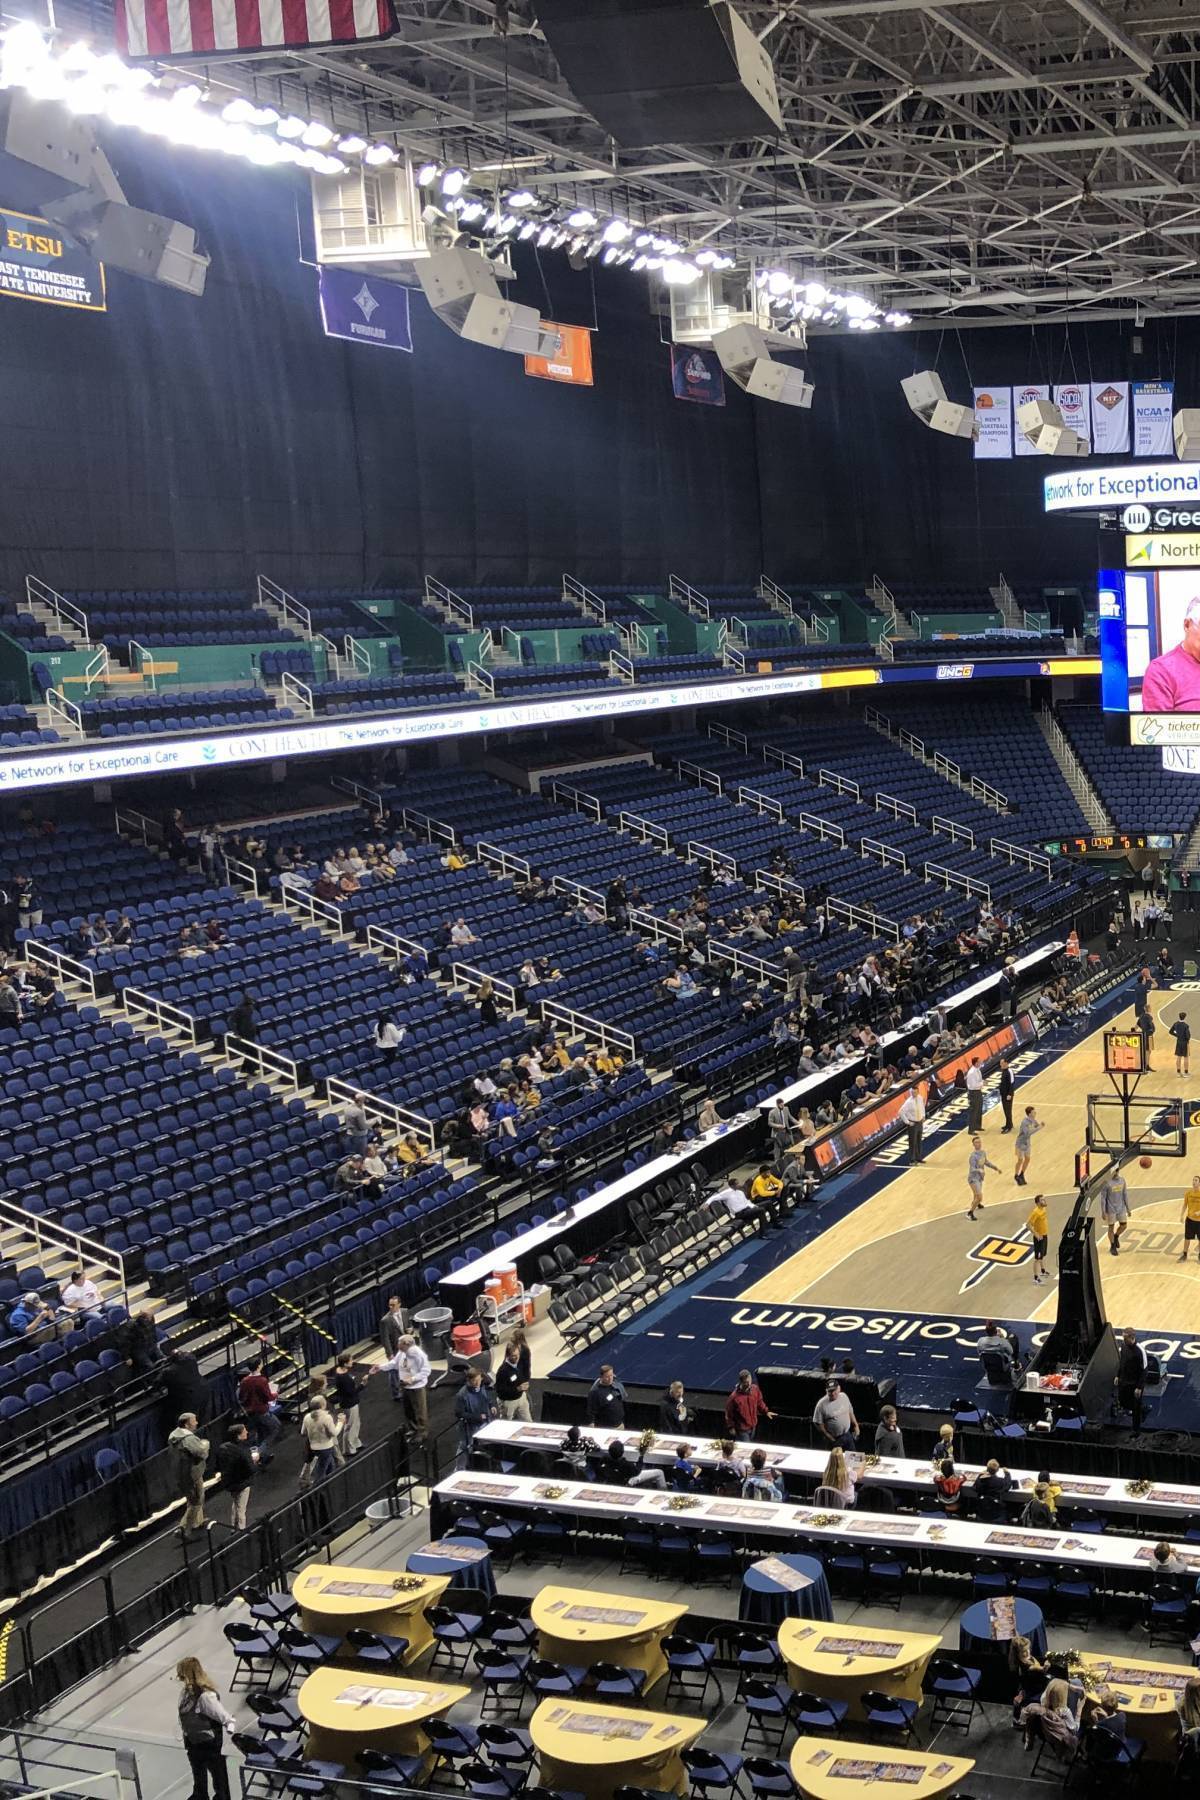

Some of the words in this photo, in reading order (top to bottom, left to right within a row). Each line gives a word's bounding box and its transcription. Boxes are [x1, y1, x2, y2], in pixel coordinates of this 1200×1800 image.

[7, 229, 62, 257] ETSU
[0, 275, 25, 291] ATE
[27, 281, 92, 303] UNIVERSITY
[22, 266, 85, 289] TENNESSEE
[1136, 407, 1162, 417] NCAA
[1077, 477, 1093, 496] for
[936, 664, 975, 680] UNCG
[11, 762, 65, 781] Network
[69, 761, 84, 773] for
[89, 751, 152, 772] Exceptional
[155, 751, 179, 764] Care
[1164, 745, 1196, 770] ONE
[730, 1306, 1008, 1348] Coliseum
